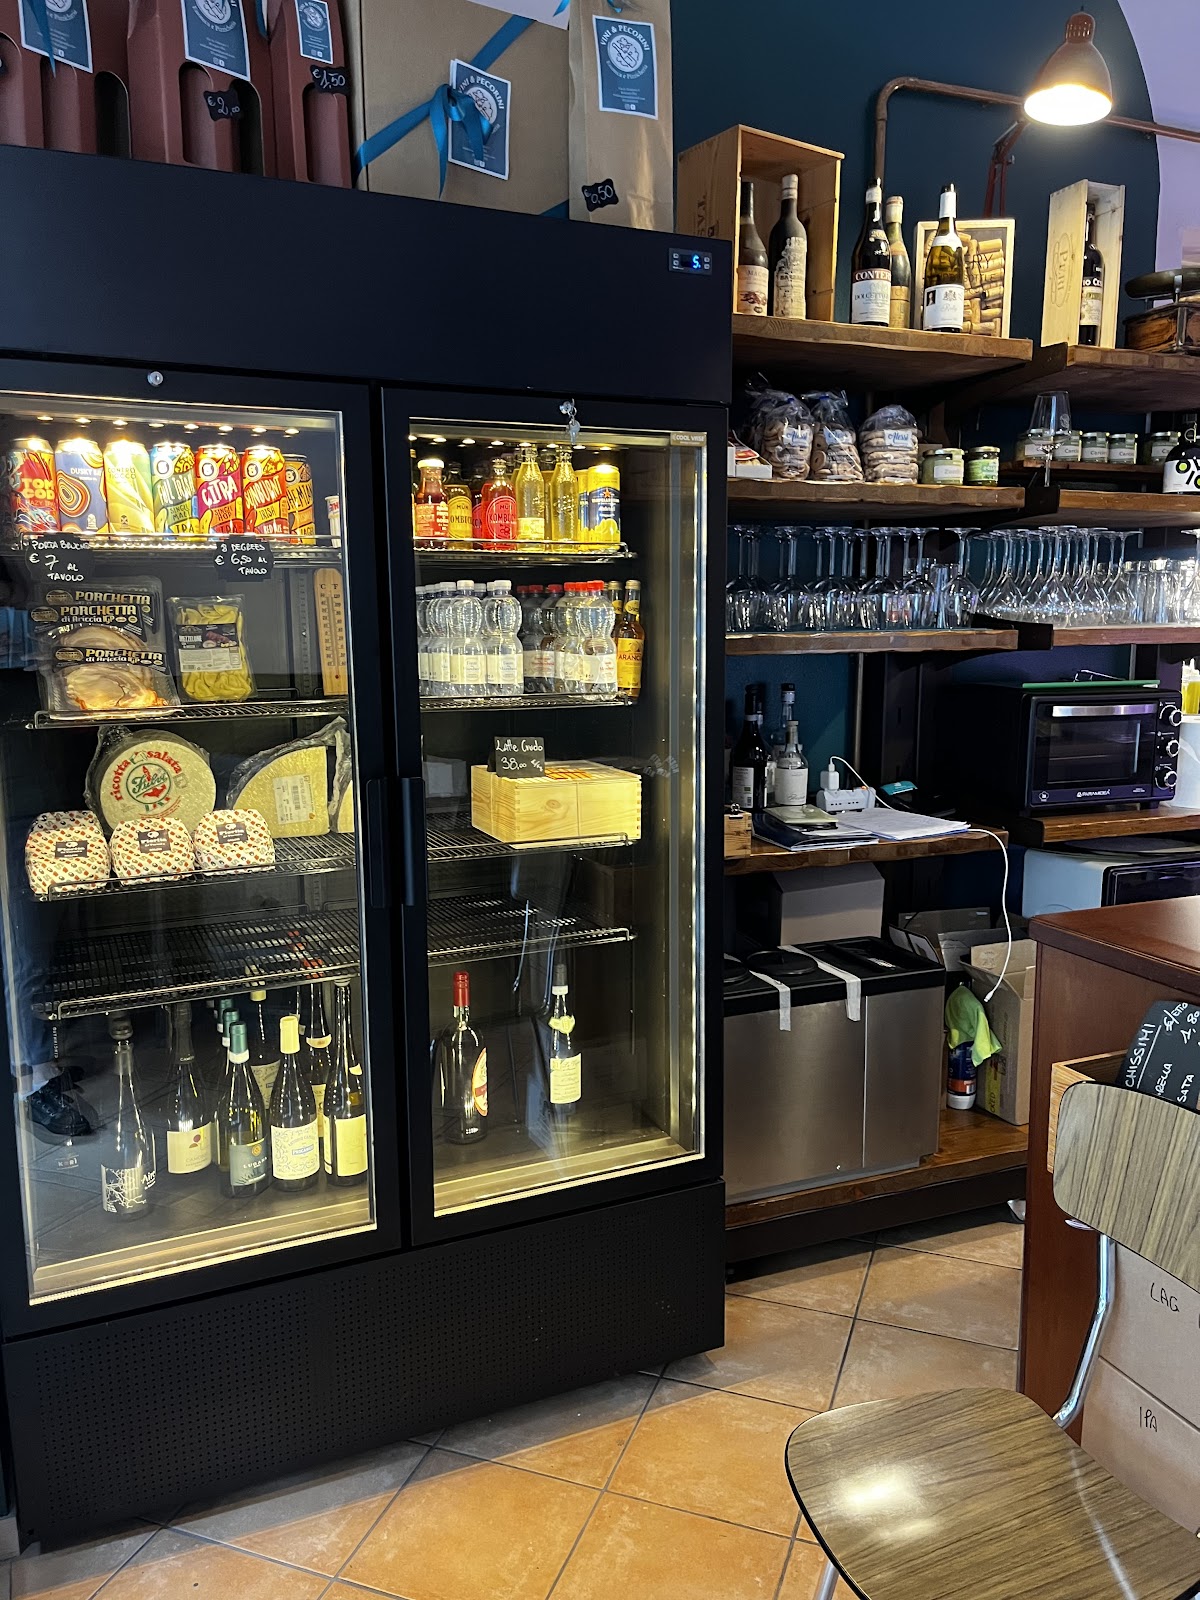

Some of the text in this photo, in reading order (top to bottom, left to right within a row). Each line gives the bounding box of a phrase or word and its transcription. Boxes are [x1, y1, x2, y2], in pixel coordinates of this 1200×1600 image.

[600, 30, 612, 46] VINI
[618, 25, 650, 51] PECORINI
[313, 69, 345, 88] € 1,50
[476, 76, 505, 109] PECORINI
[591, 185, 613, 204] 0,50
[71, 467, 93, 475] DUSKY
[21, 478, 55, 490] TOM
[22, 489, 56, 500] COD
[201, 475, 238, 509] CITRA
[244, 475, 284, 510] SUNBURNT
[258, 508, 277, 521] IRISH
[31, 540, 59, 550] PORTA
[220, 543, 266, 552] 8 DEGREES
[29, 553, 79, 571] € 7 AL
[215, 555, 225, 565] €
[231, 553, 252, 565] 6,50
[47, 573, 84, 581] TAVOLO
[238, 566, 268, 575] TAVOLO
[75, 591, 151, 605] PORCHETTA
[60, 605, 137, 616] PORCHETTA
[72, 615, 102, 623] Ariccia
[85, 649, 162, 661] PORCHETTA
[496, 739, 543, 752] Latte Crudo
[110, 751, 182, 802] ricotta salata
[1125, 1023, 1157, 1088] CHISSIMI
[1150, 1284, 1180, 1312] LAG
[1140, 1406, 1157, 1432] IPA
